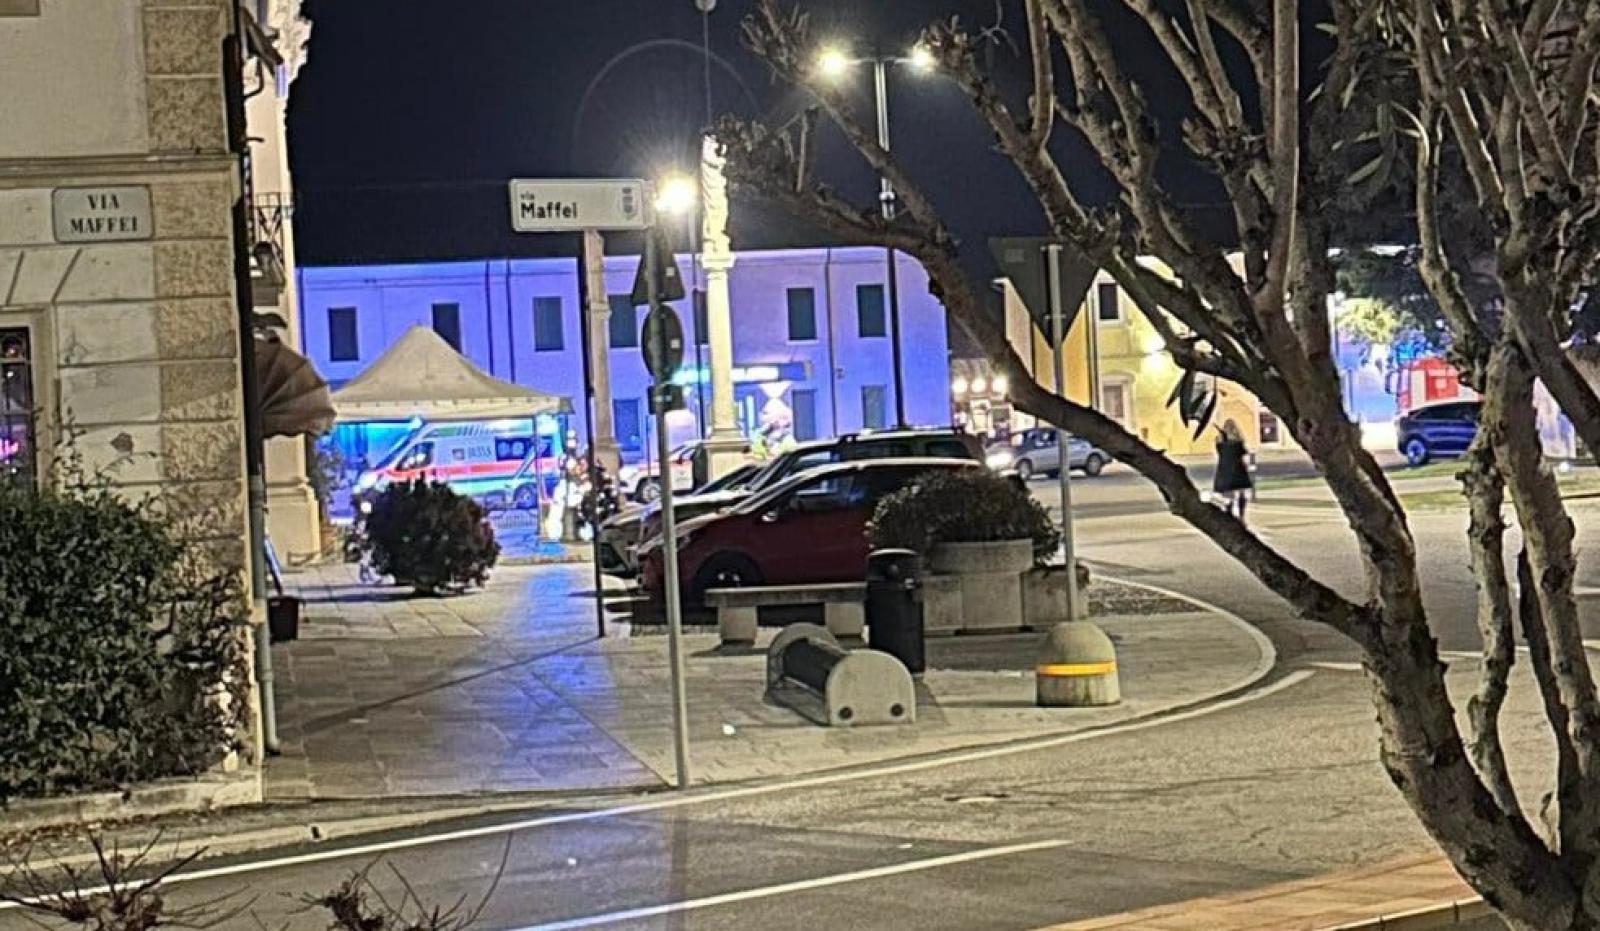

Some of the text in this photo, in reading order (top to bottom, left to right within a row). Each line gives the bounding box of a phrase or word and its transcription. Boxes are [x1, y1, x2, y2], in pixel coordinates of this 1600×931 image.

[87, 194, 119, 210] VIA
[520, 202, 577, 218] Maffei
[70, 216, 137, 233] MAFFEI
